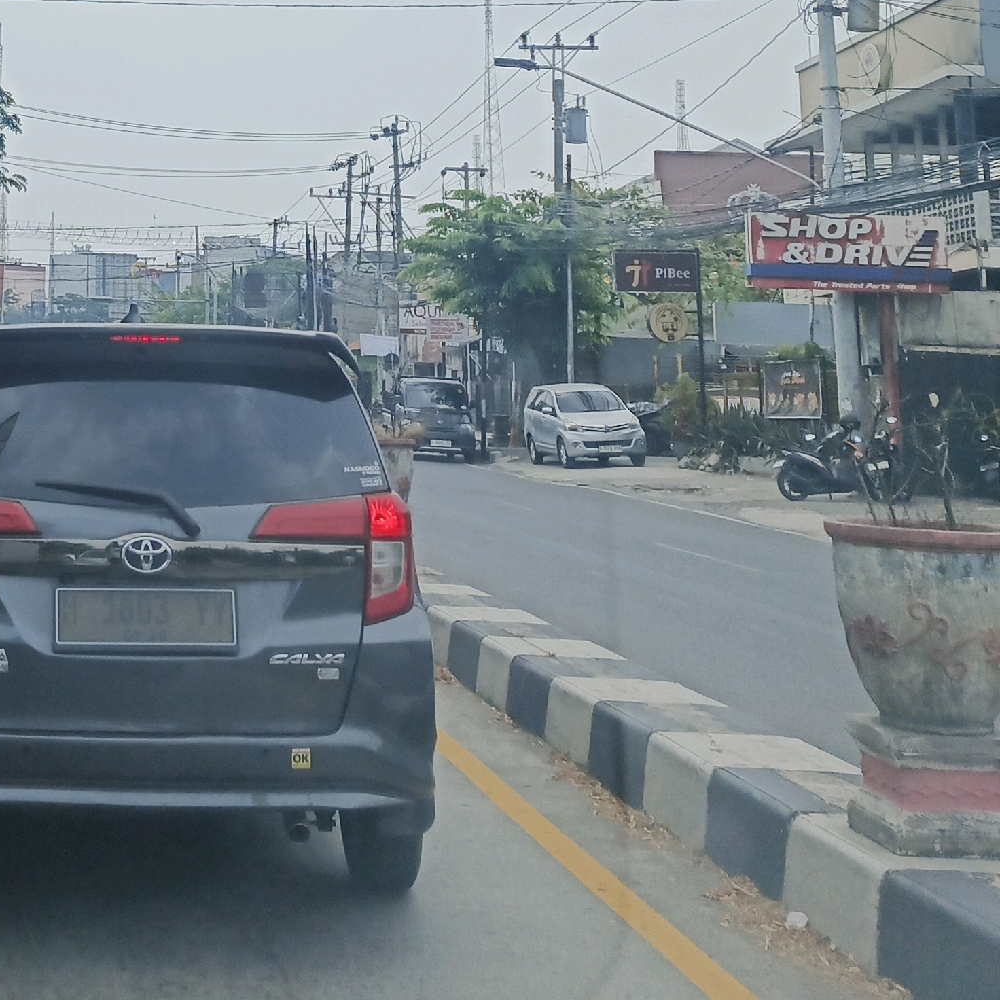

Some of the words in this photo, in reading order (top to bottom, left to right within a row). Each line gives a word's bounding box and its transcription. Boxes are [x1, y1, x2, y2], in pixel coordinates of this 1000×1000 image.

[760, 214, 873, 240] SHOP
[813, 280, 828, 288] The
[832, 281, 864, 290] Trusted
[865, 282, 891, 290] Parts
[268, 653, 345, 665] CALYA
[293, 753, 309, 763] OK
